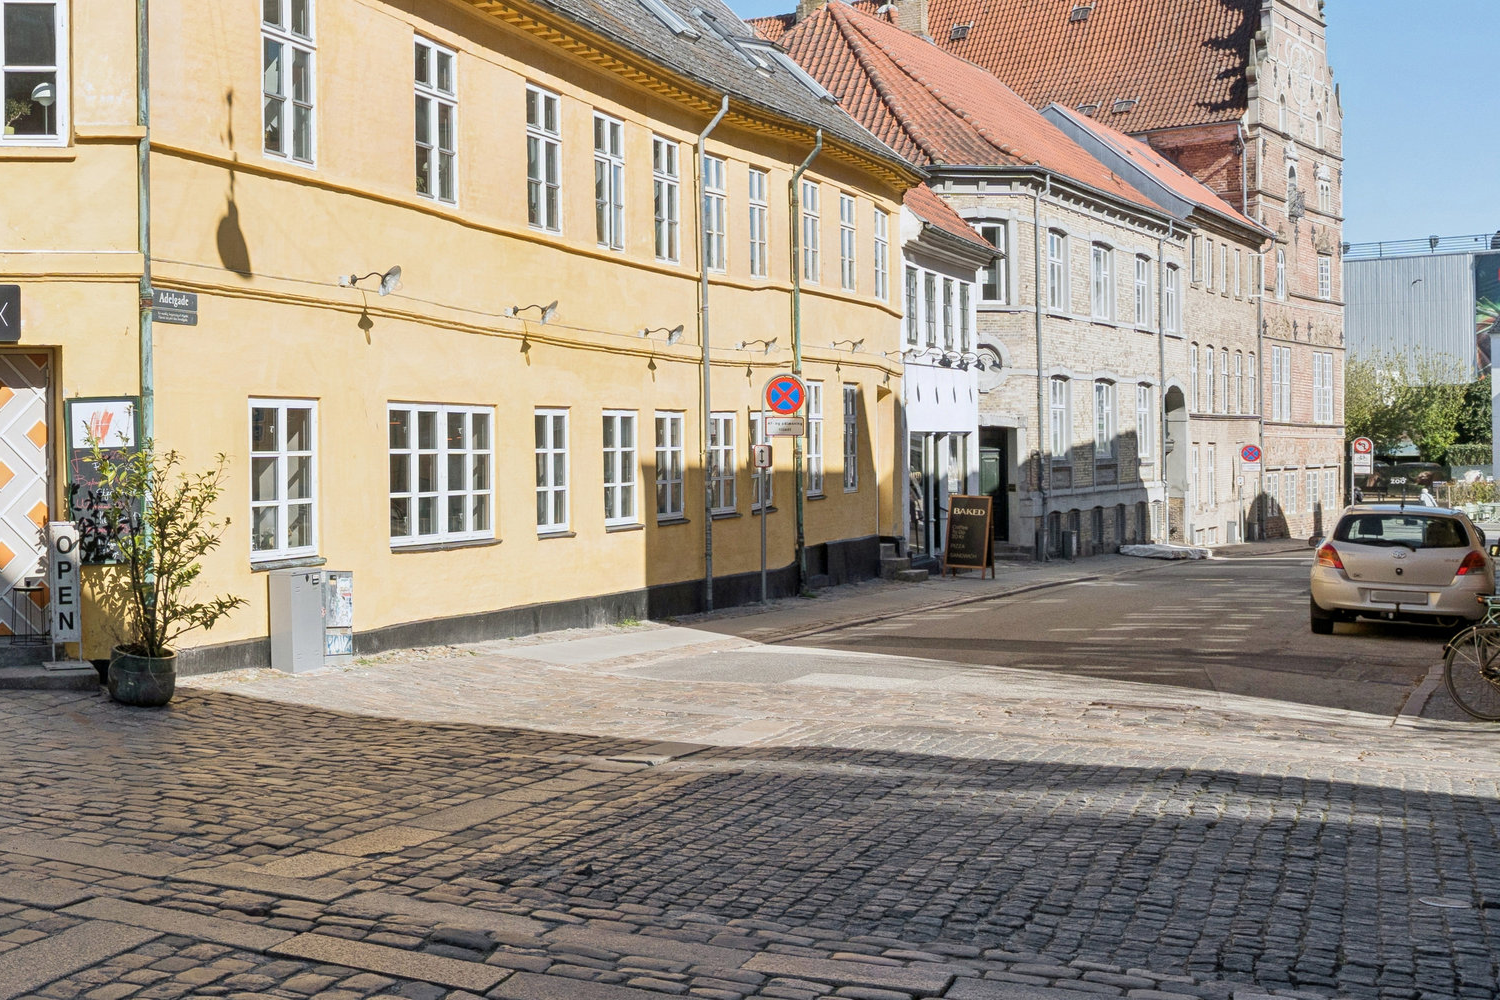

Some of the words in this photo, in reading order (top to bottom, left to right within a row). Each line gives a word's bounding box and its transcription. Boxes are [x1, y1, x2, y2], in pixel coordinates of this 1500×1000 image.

[158, 292, 189, 308] Adelgade
[953, 507, 986, 516] BAKED
[56, 535, 74, 630] OPEN
